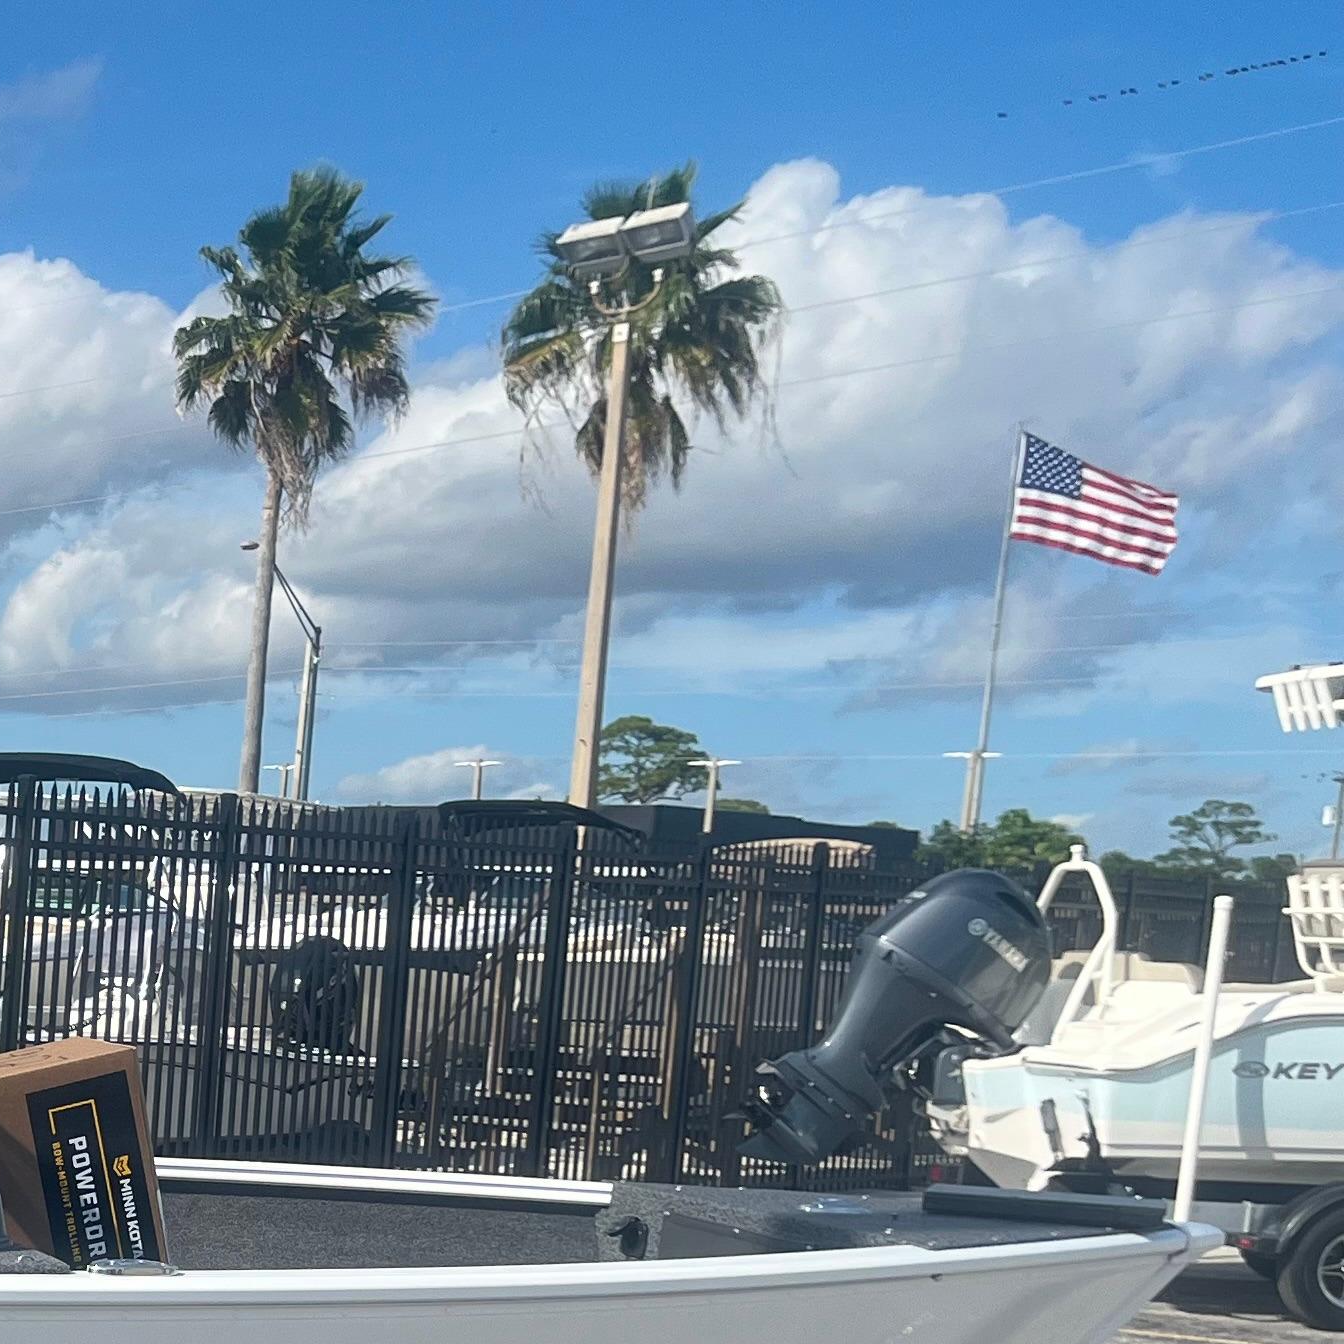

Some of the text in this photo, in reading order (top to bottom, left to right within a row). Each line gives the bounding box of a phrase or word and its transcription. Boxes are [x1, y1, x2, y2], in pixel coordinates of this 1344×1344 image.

[64, 1210, 83, 1263] TROLLING
[68, 1135, 108, 1262] POWERDR
[119, 1178, 144, 1259] MINN KOTA
